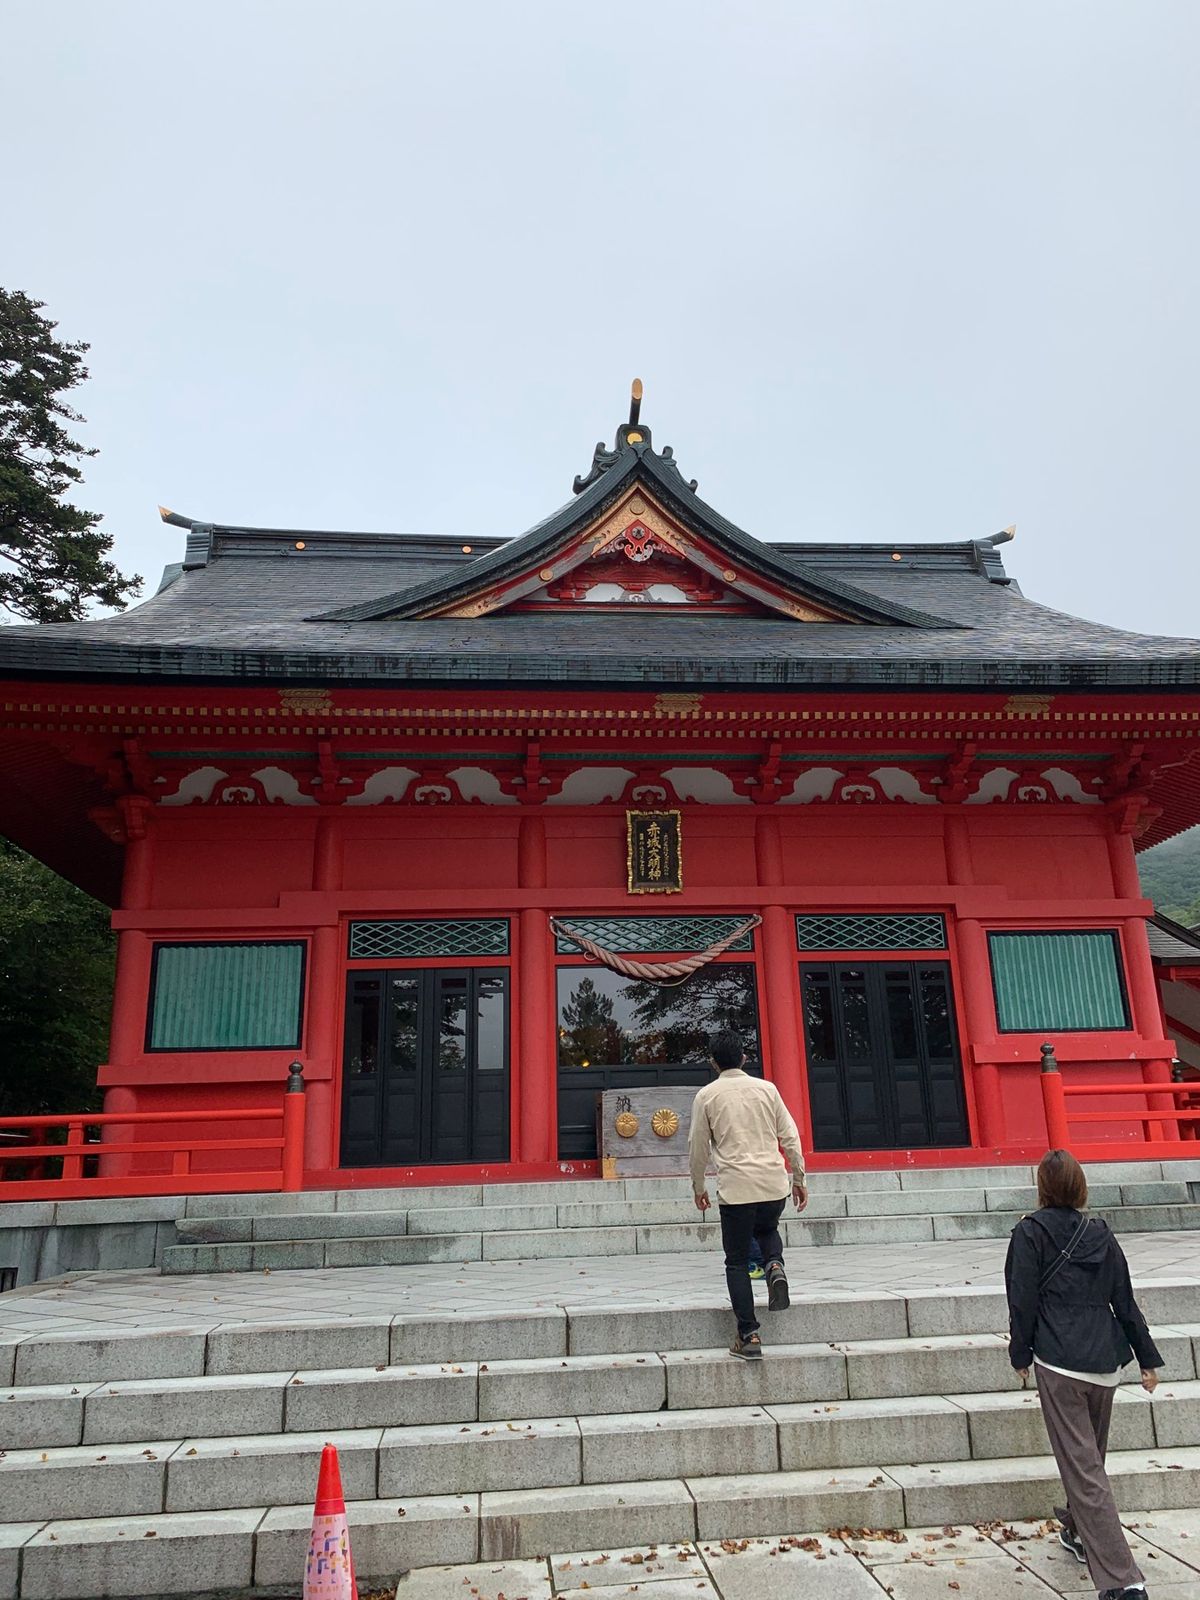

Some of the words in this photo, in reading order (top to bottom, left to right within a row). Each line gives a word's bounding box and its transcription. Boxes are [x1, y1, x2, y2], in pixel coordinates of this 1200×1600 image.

[646, 821, 662, 881] 赤城大明神
